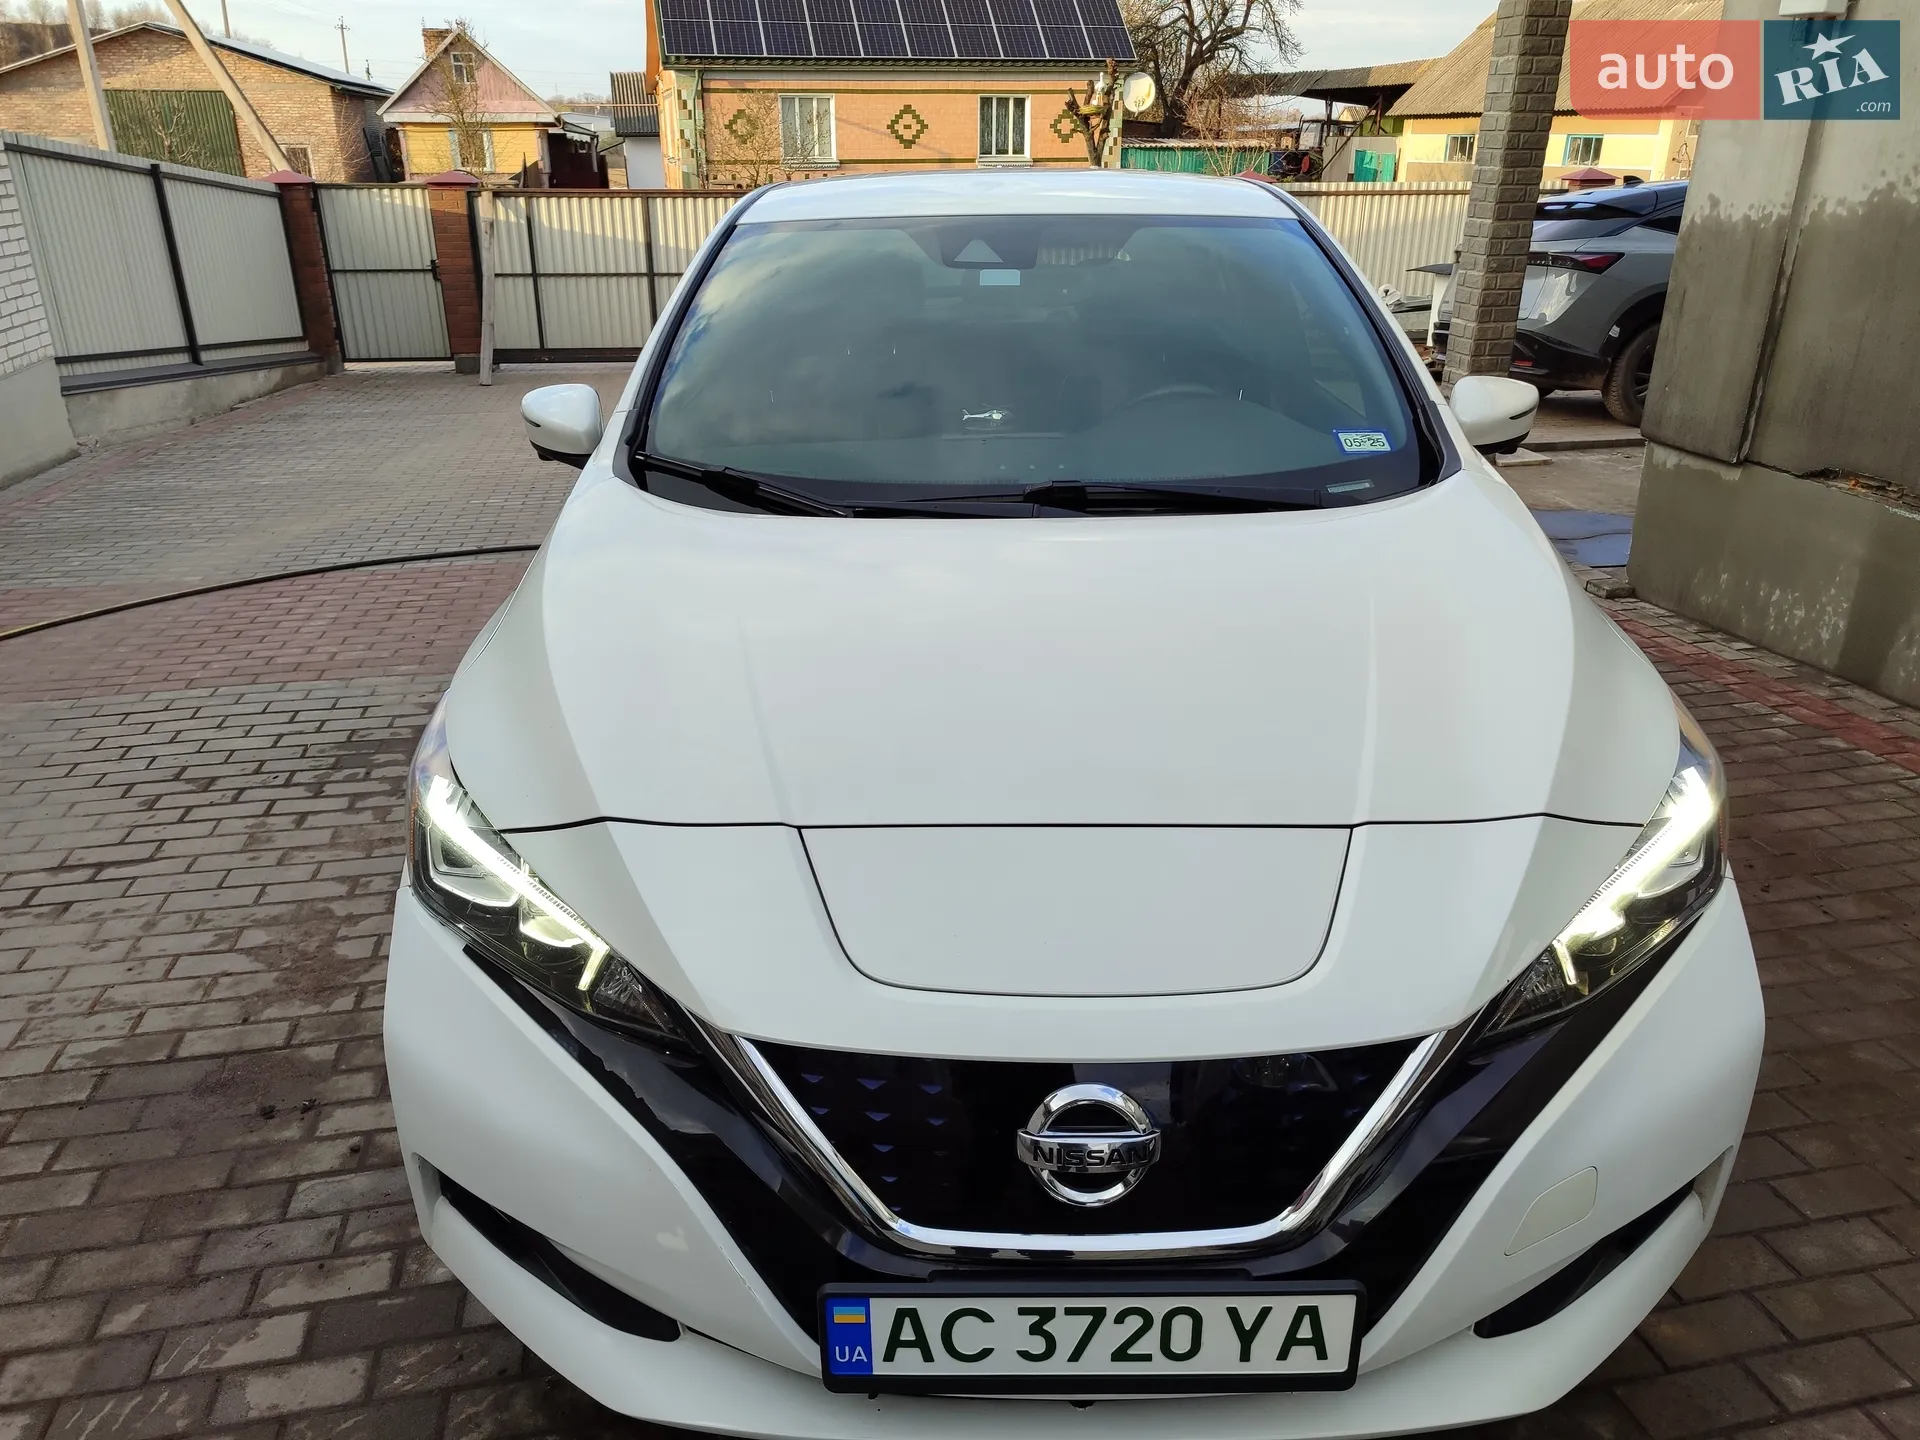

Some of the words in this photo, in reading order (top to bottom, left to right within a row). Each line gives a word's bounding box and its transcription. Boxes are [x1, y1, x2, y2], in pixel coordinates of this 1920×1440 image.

[1033, 1145, 1149, 1167] NISSAN
[882, 1307, 995, 1363] AC
[1016, 1306, 1203, 1363] 3720
[1226, 1305, 1329, 1363] YA
[835, 1346, 868, 1363] UA
